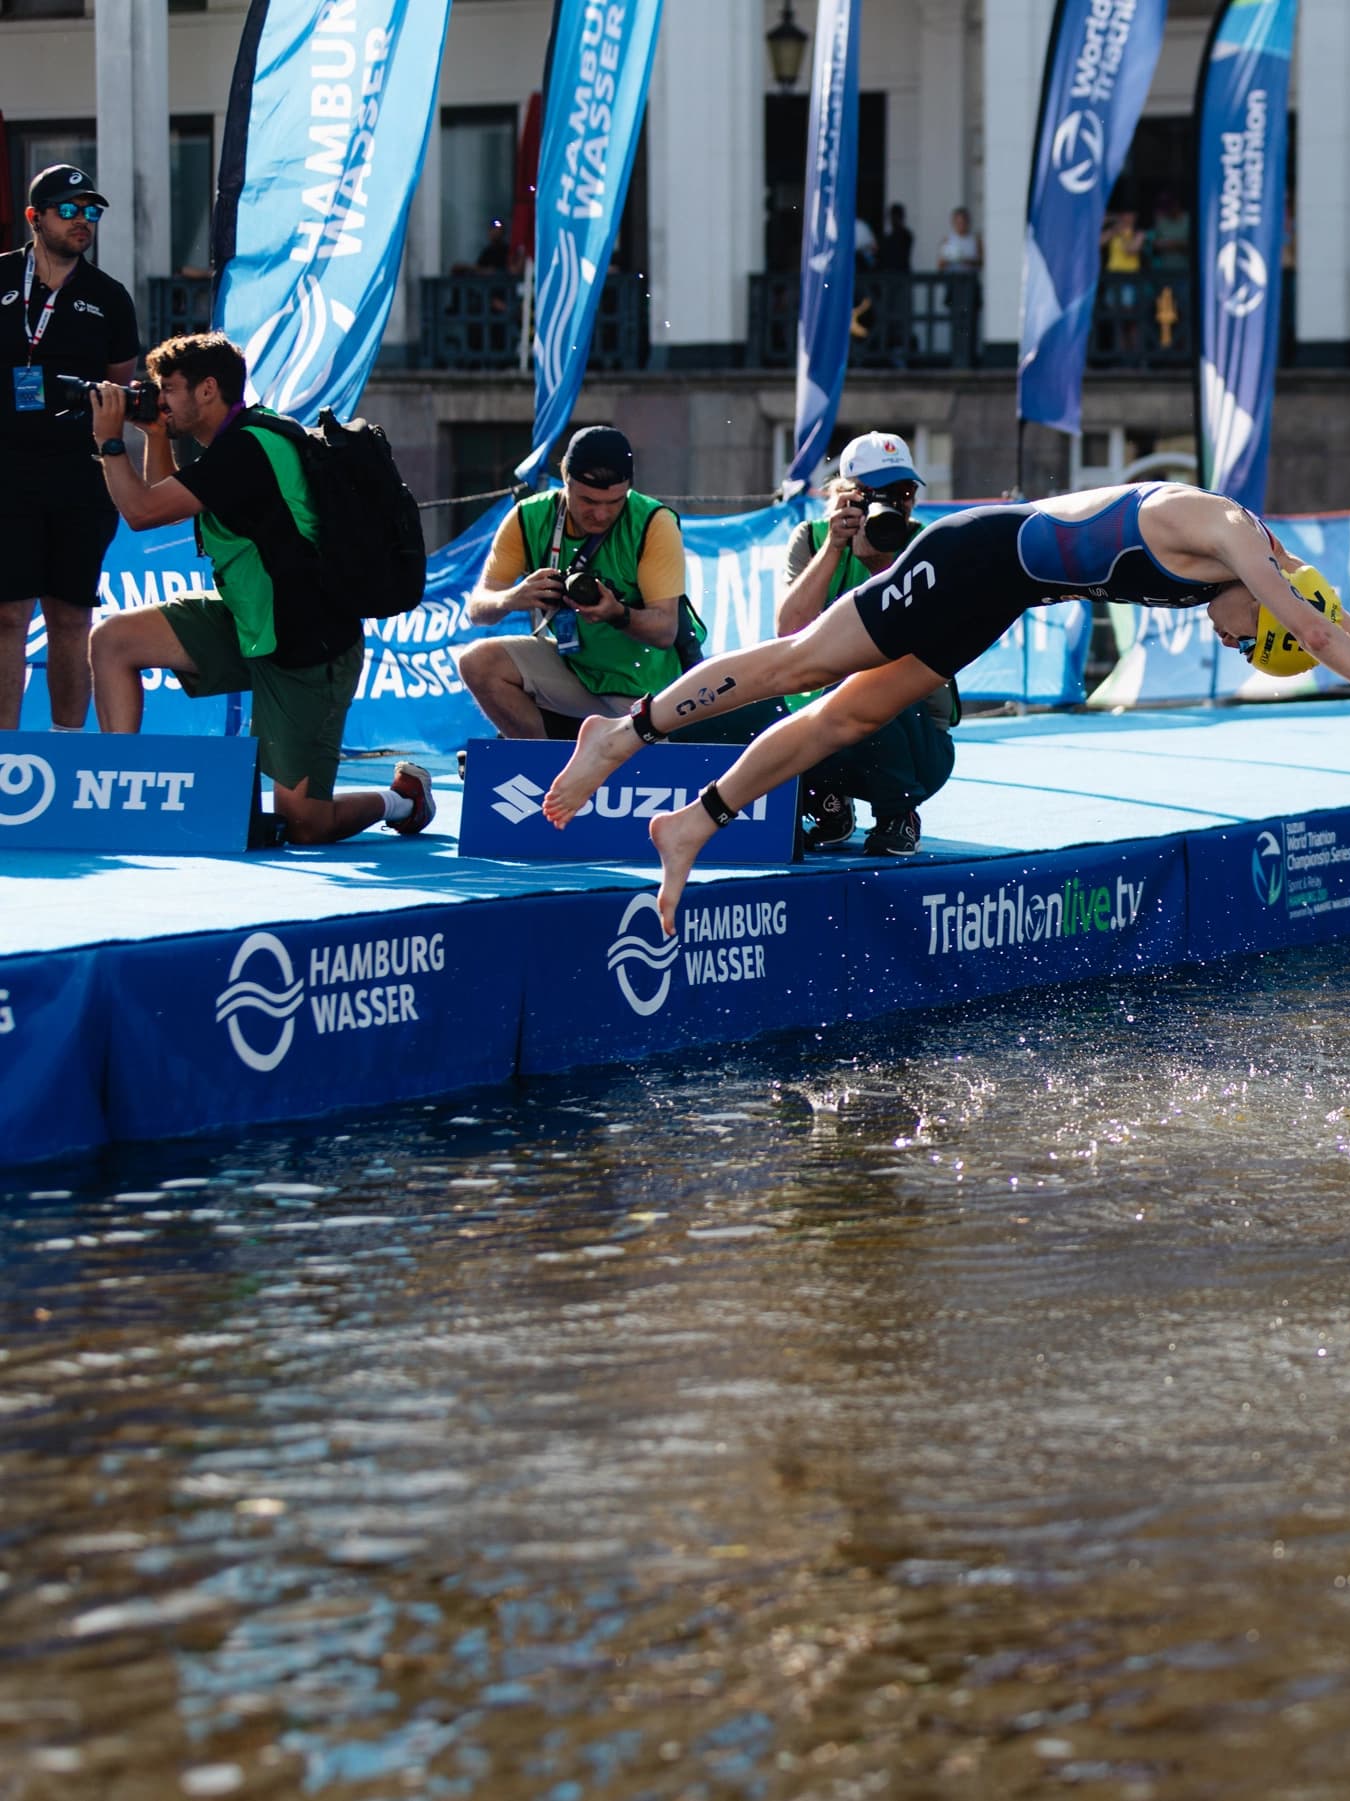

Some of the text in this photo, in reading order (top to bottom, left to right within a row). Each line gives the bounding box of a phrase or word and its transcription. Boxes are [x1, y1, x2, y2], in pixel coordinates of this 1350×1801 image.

[289, 0, 357, 263] HAMBUR
[316, 25, 395, 260] WASSER
[556, 0, 608, 216] HAMBU
[573, 3, 626, 219] WASSER
[1220, 132, 1244, 232] World
[1245, 89, 1267, 227] Triathlon
[353, 646, 472, 700] ASSE
[72, 770, 195, 811] NTT
[309, 932, 445, 988] HAMBURG
[684, 900, 787, 944] HAMBURG
[684, 944, 766, 986] WASSER
[310, 984, 420, 1035] WASSER
